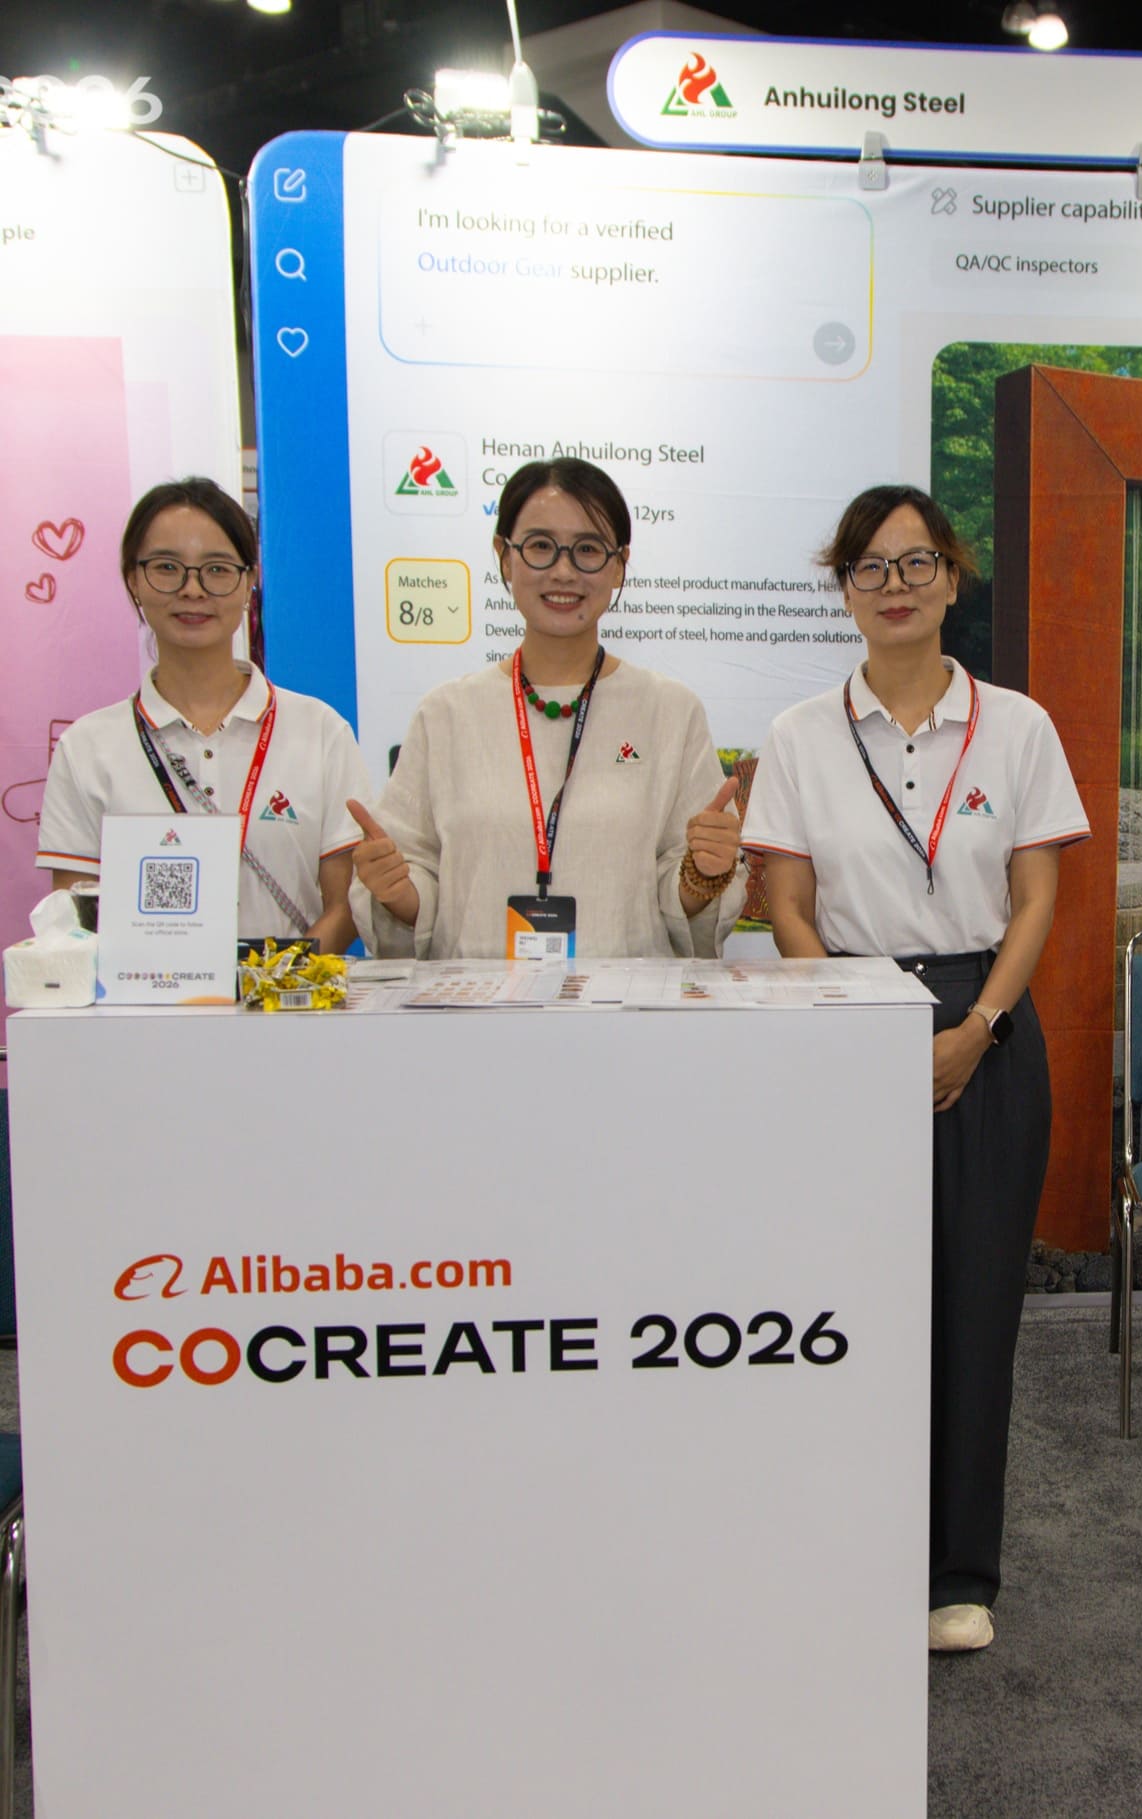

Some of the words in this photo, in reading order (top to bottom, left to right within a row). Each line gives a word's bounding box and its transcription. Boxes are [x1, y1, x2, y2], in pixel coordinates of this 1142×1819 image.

[764, 86, 896, 117] Anhuilong
[904, 91, 965, 114] Steel
[972, 194, 1055, 220] Supplier
[2, 224, 36, 246] ple
[418, 208, 449, 229] I'm
[456, 210, 535, 238] looking
[543, 213, 569, 235] for
[577, 223, 588, 236] a
[596, 220, 673, 241] verified
[418, 251, 507, 275] Outdoor
[515, 257, 562, 278] Gear
[570, 262, 659, 286] supplier.
[956, 254, 1012, 274] QA/QC
[1016, 255, 1098, 276] inspectors
[482, 438, 545, 458] Henan
[551, 441, 652, 466] Anhuilong
[659, 444, 705, 463] Steel
[482, 468, 508, 486] Co
[436, 489, 458, 497] GROUP
[634, 505, 675, 521] 12yrs
[398, 575, 448, 589] Matches
[484, 571, 499, 584] As
[622, 577, 651, 589] orten
[654, 577, 681, 589] steel
[683, 577, 728, 593] product
[731, 578, 816, 593] manufacturers,
[399, 600, 434, 626] 8/8
[623, 602, 643, 614] has
[645, 602, 674, 615] been
[677, 603, 742, 619] specializing
[744, 603, 755, 616] in
[757, 604, 776, 616] the
[778, 604, 828, 618] Research
[485, 624, 526, 637] Develo
[601, 628, 623, 639] and
[625, 628, 663, 642] export
[665, 627, 678, 639] of
[679, 628, 709, 642] steel,
[710, 628, 744, 641] home
[746, 630, 768, 642] and
[770, 630, 810, 645] garden
[812, 630, 862, 644] solutions
[200, 1254, 513, 1295] Alibaba.com
[112, 1317, 600, 1388] COCREATE
[629, 1310, 850, 1370] 2026
